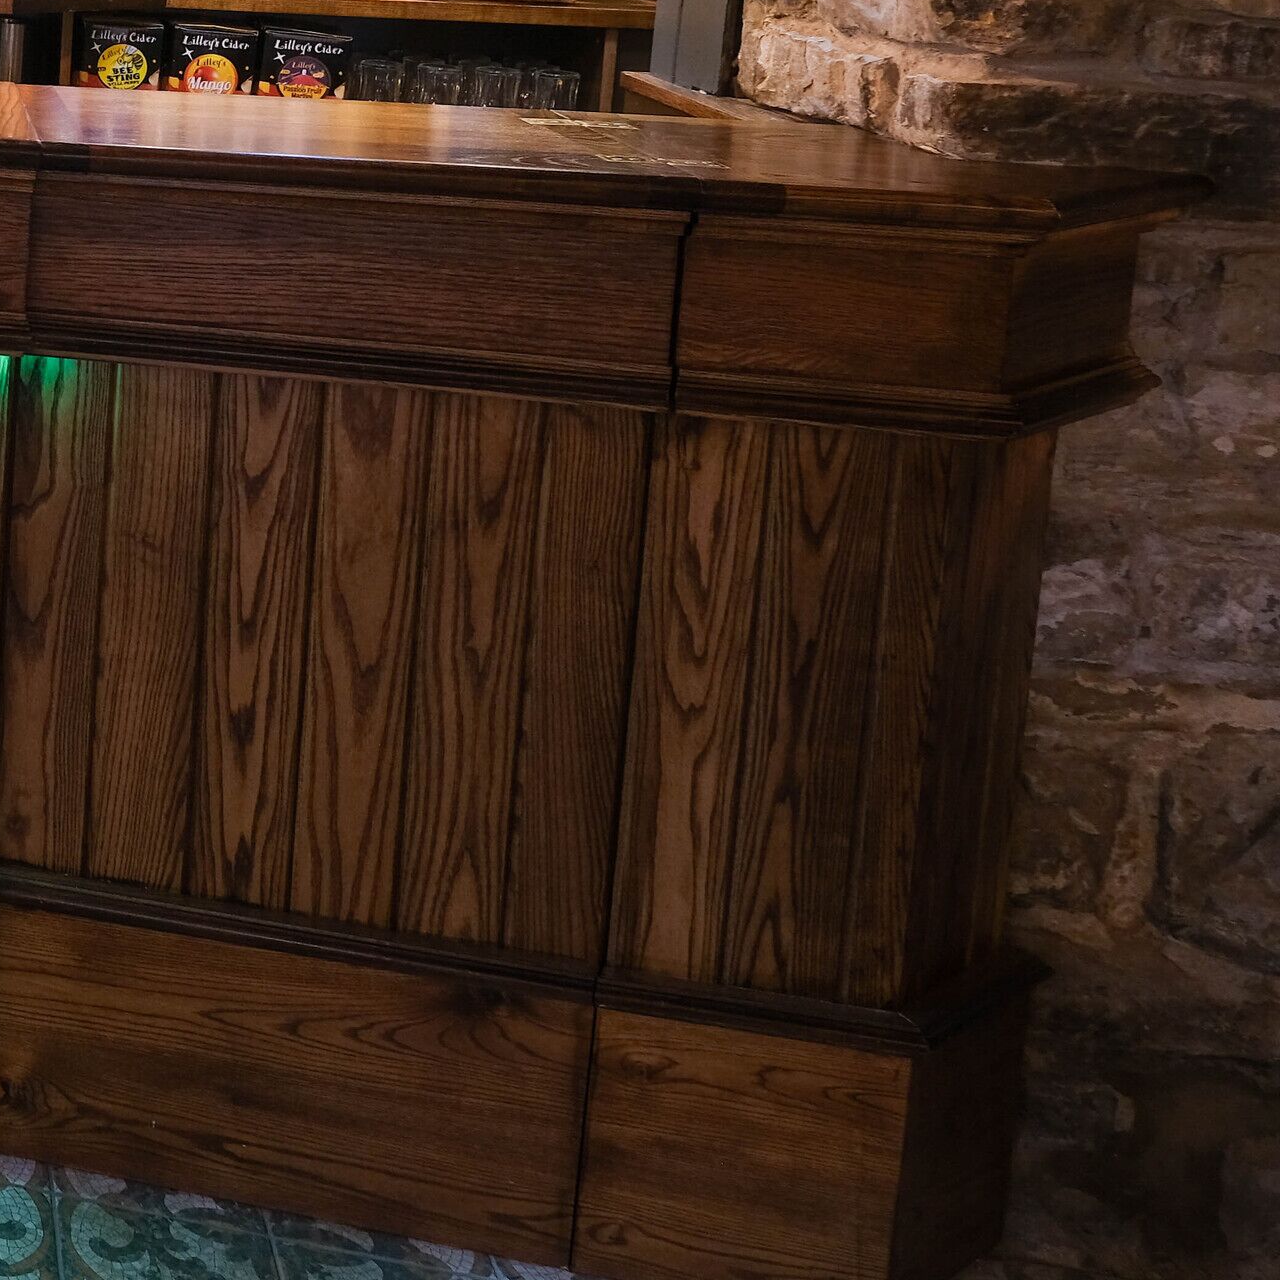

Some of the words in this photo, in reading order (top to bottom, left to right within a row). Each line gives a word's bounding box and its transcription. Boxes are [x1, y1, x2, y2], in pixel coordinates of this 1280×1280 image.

[91, 29, 127, 42] Lilley's
[129, 32, 157, 44] Cider
[182, 35, 220, 51] Lilley's
[221, 38, 251, 51] Cider
[274, 39, 312, 56] Lilley's
[313, 42, 345, 55] Cider
[106, 73, 141, 83] STING
[112, 66, 134, 75] BEE
[187, 76, 232, 93] Mango
